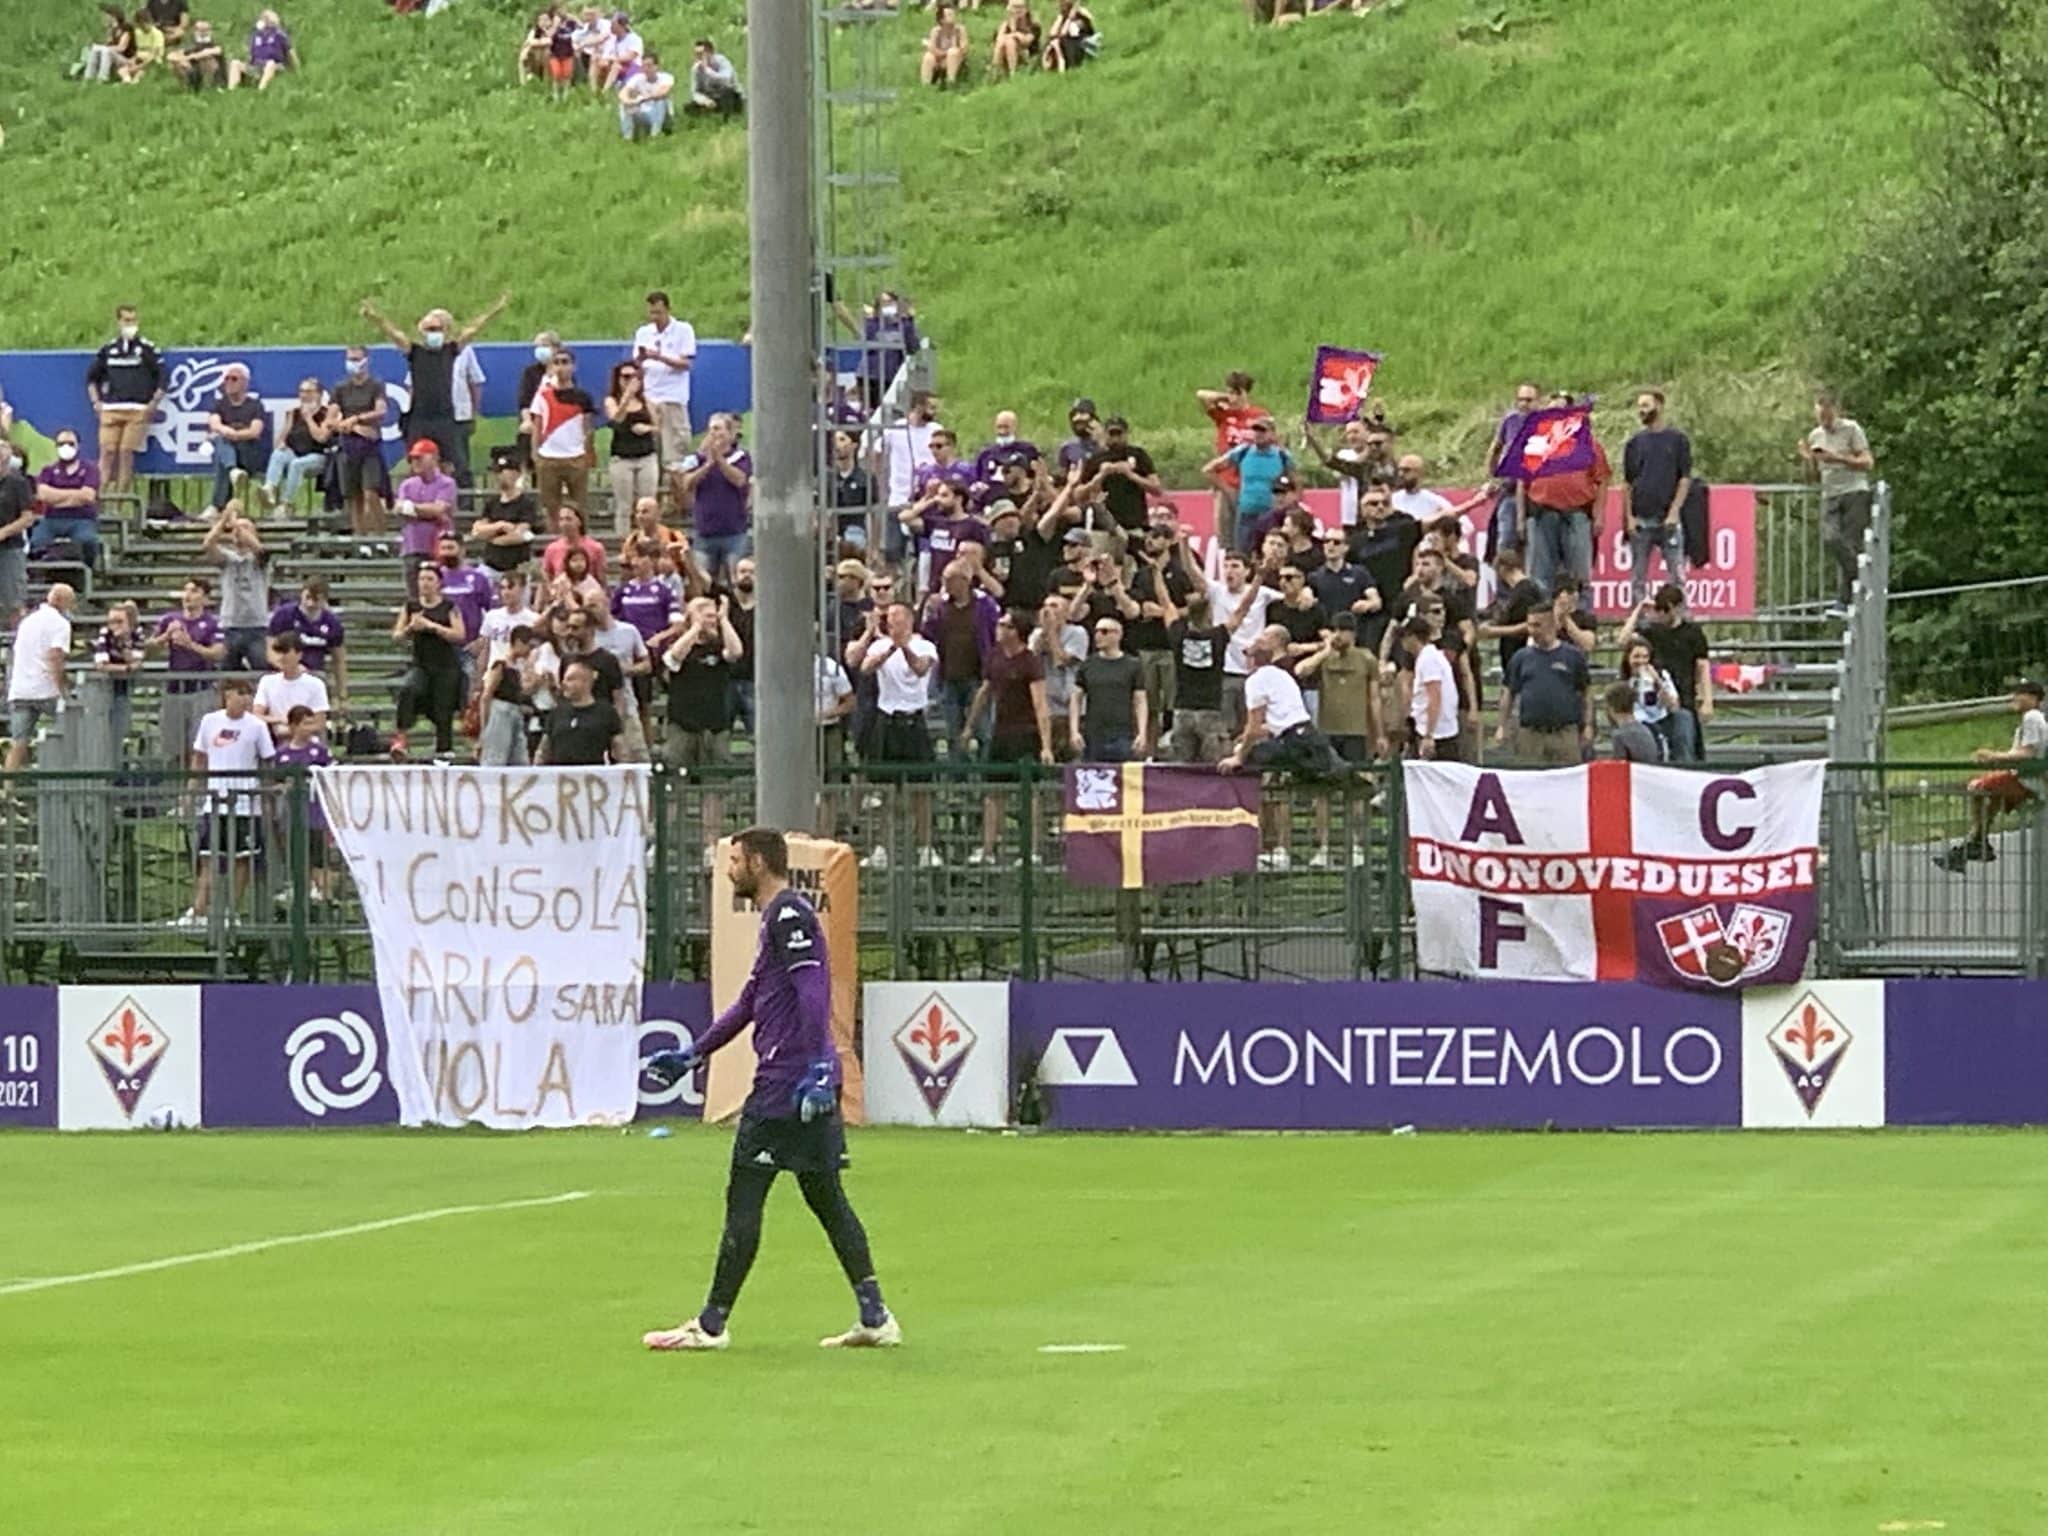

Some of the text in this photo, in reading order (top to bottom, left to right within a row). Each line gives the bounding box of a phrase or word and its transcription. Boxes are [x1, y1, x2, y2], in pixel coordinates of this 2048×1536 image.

[1686, 579, 1737, 608] 2021
[317, 770, 484, 839] NONNO
[1460, 773, 1757, 852] A C
[1417, 843, 1814, 896] UNONOVEDUESEI
[1479, 896, 1526, 969] F
[404, 947, 539, 1026] ARIO
[4, 1034, 39, 1073] 10
[1173, 1027, 1722, 1085] MONTEZEMOLO
